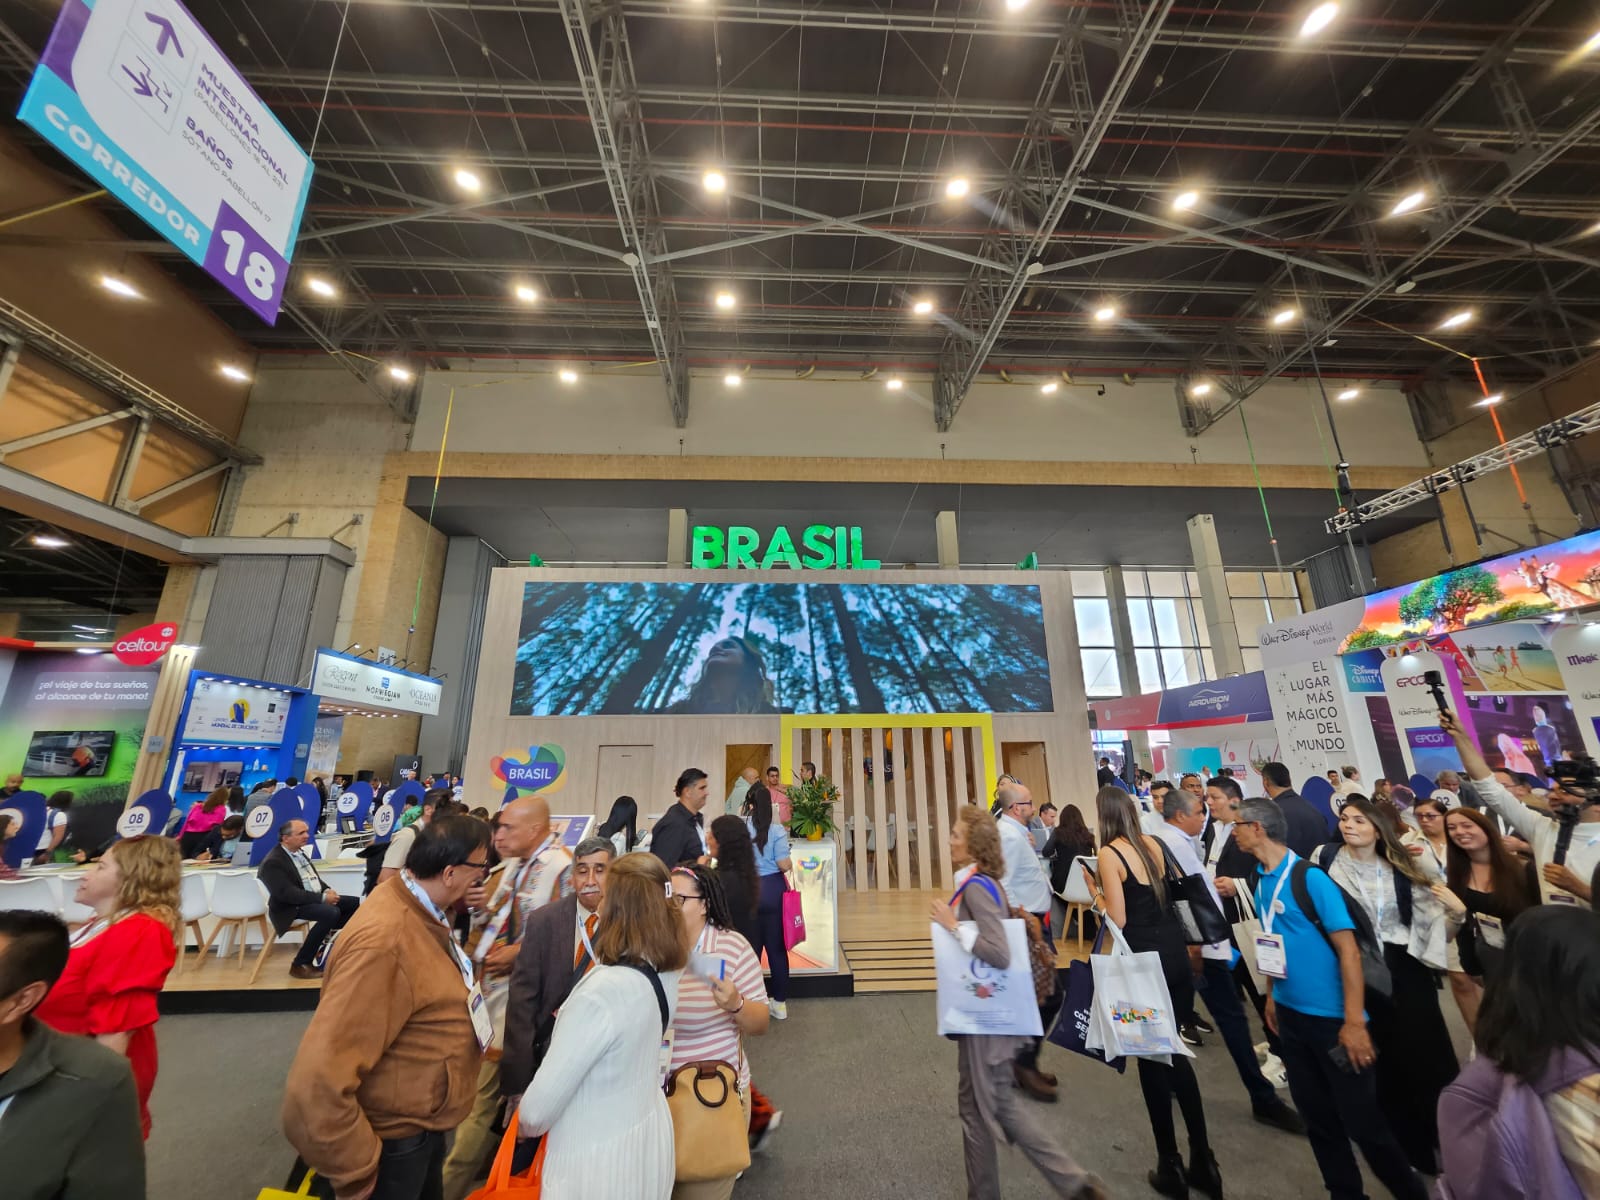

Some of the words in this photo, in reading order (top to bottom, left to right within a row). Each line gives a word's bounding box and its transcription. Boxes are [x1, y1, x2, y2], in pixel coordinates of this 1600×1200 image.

[201, 63, 260, 135] MUESTRA
[197, 76, 289, 184] INTERNACIONAL
[186, 116, 233, 170] BAÑOS
[45, 104, 200, 246] CORREDOR
[221, 229, 276, 300] 18
[692, 524, 881, 570] BRASIL
[116, 638, 169, 652] celtour
[1312, 660, 1327, 672] EL
[55, 681, 79, 690] viaje
[80, 681, 93, 689] de
[95, 680, 113, 689] tus
[113, 680, 149, 690] sueños,
[1290, 675, 1330, 691] LUGAR
[1396, 676, 1425, 687] EPCO
[35, 692, 46, 701] al
[47, 692, 87, 701] alcance
[89, 692, 102, 701] de
[104, 692, 115, 701] tu
[116, 692, 149, 701] mano!
[1306, 688, 1334, 704] MÁS
[1286, 706, 1338, 721] MÁGICO
[1317, 721, 1342, 734] DEL
[1296, 737, 1345, 751] MUNDO
[1415, 734, 1444, 743] EPCOT
[509, 768, 552, 779] BRASIL
[129, 813, 144, 824] 08
[256, 812, 268, 823] 07
[380, 811, 390, 823] 06
